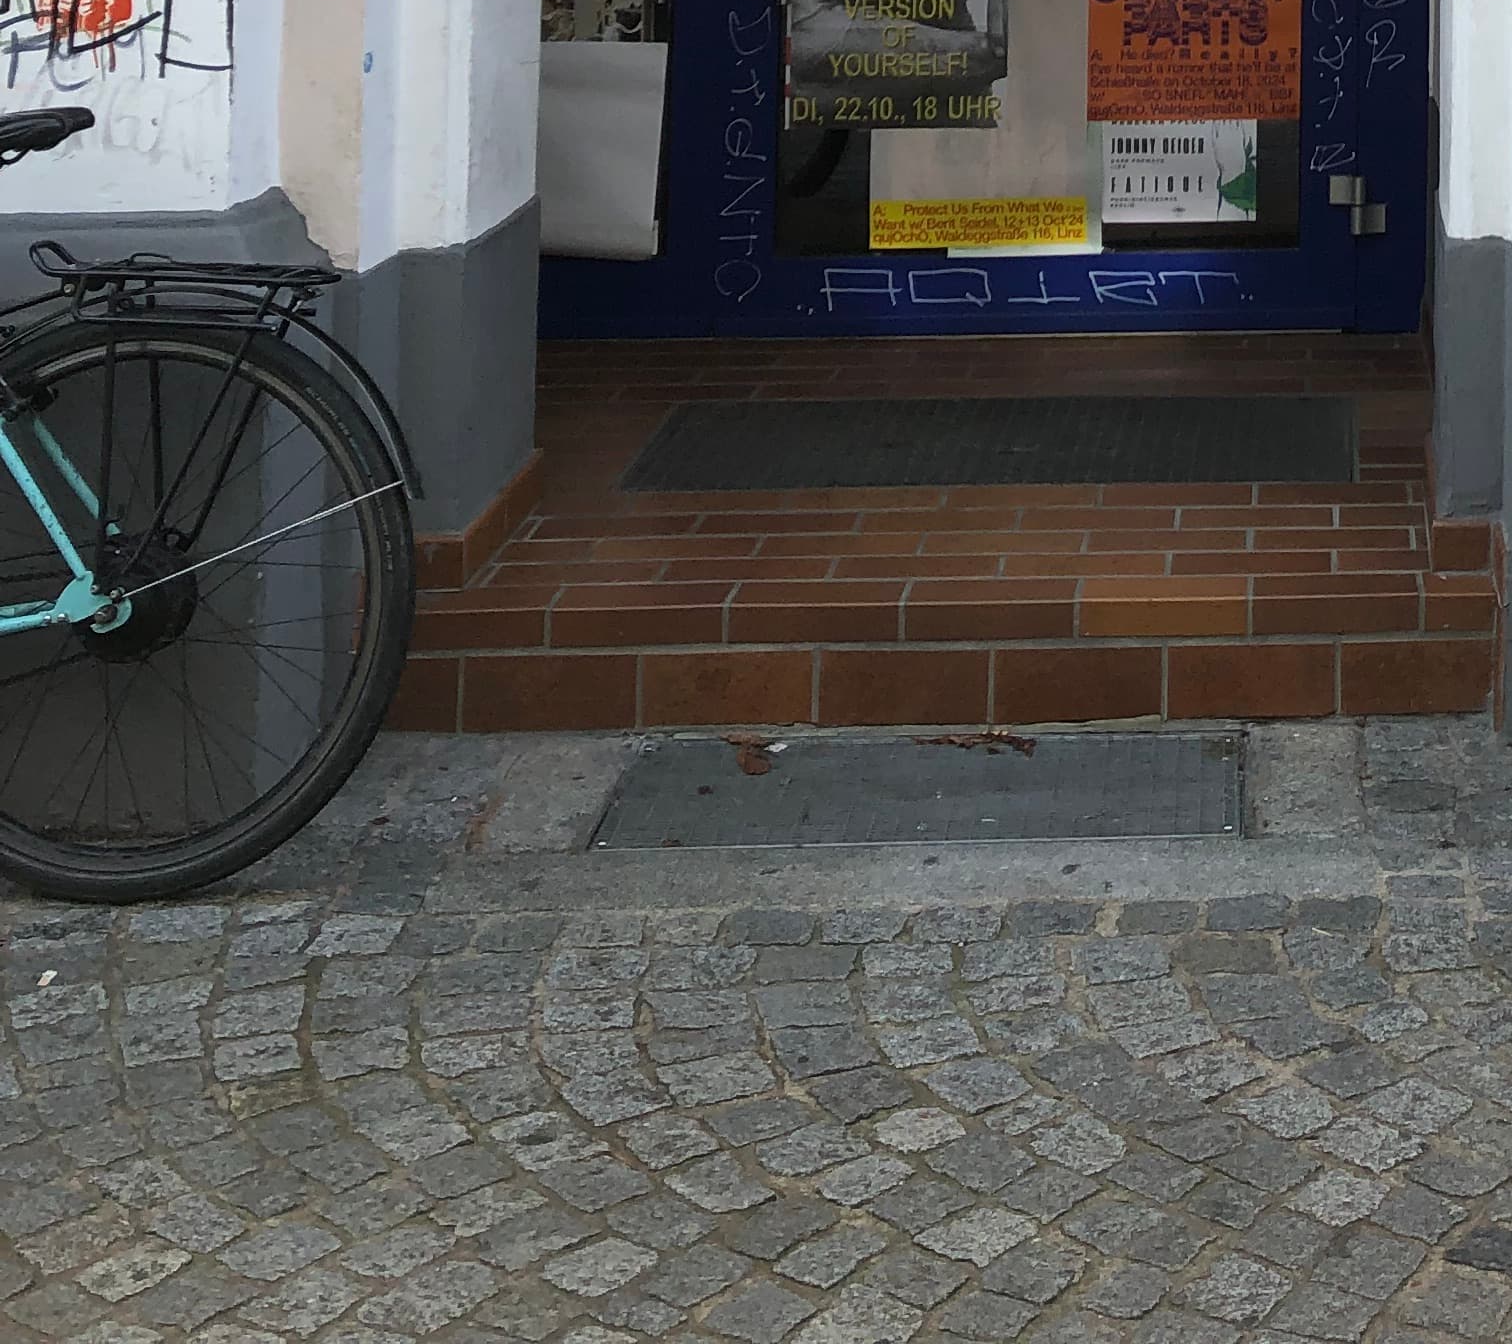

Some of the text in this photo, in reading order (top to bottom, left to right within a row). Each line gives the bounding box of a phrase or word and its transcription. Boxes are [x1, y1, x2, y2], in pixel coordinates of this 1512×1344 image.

[881, 26, 917, 48] OF
[827, 52, 969, 78] YOURSELF!
[792, 97, 824, 126] DI,
[912, 96, 938, 121] 18
[949, 95, 1003, 121] UHR
[1111, 137, 1156, 154] JOHNNY
[903, 203, 947, 216] Protect
[951, 203, 968, 215] Us
[972, 202, 1005, 214] From
[1007, 201, 1040, 213] What
[1043, 200, 1064, 212] We
[874, 219, 906, 231] Want
[1003, 215, 1040, 228] 12+13
[935, 227, 1027, 244] Waldeggstraße
[1057, 225, 1083, 238] Linz
